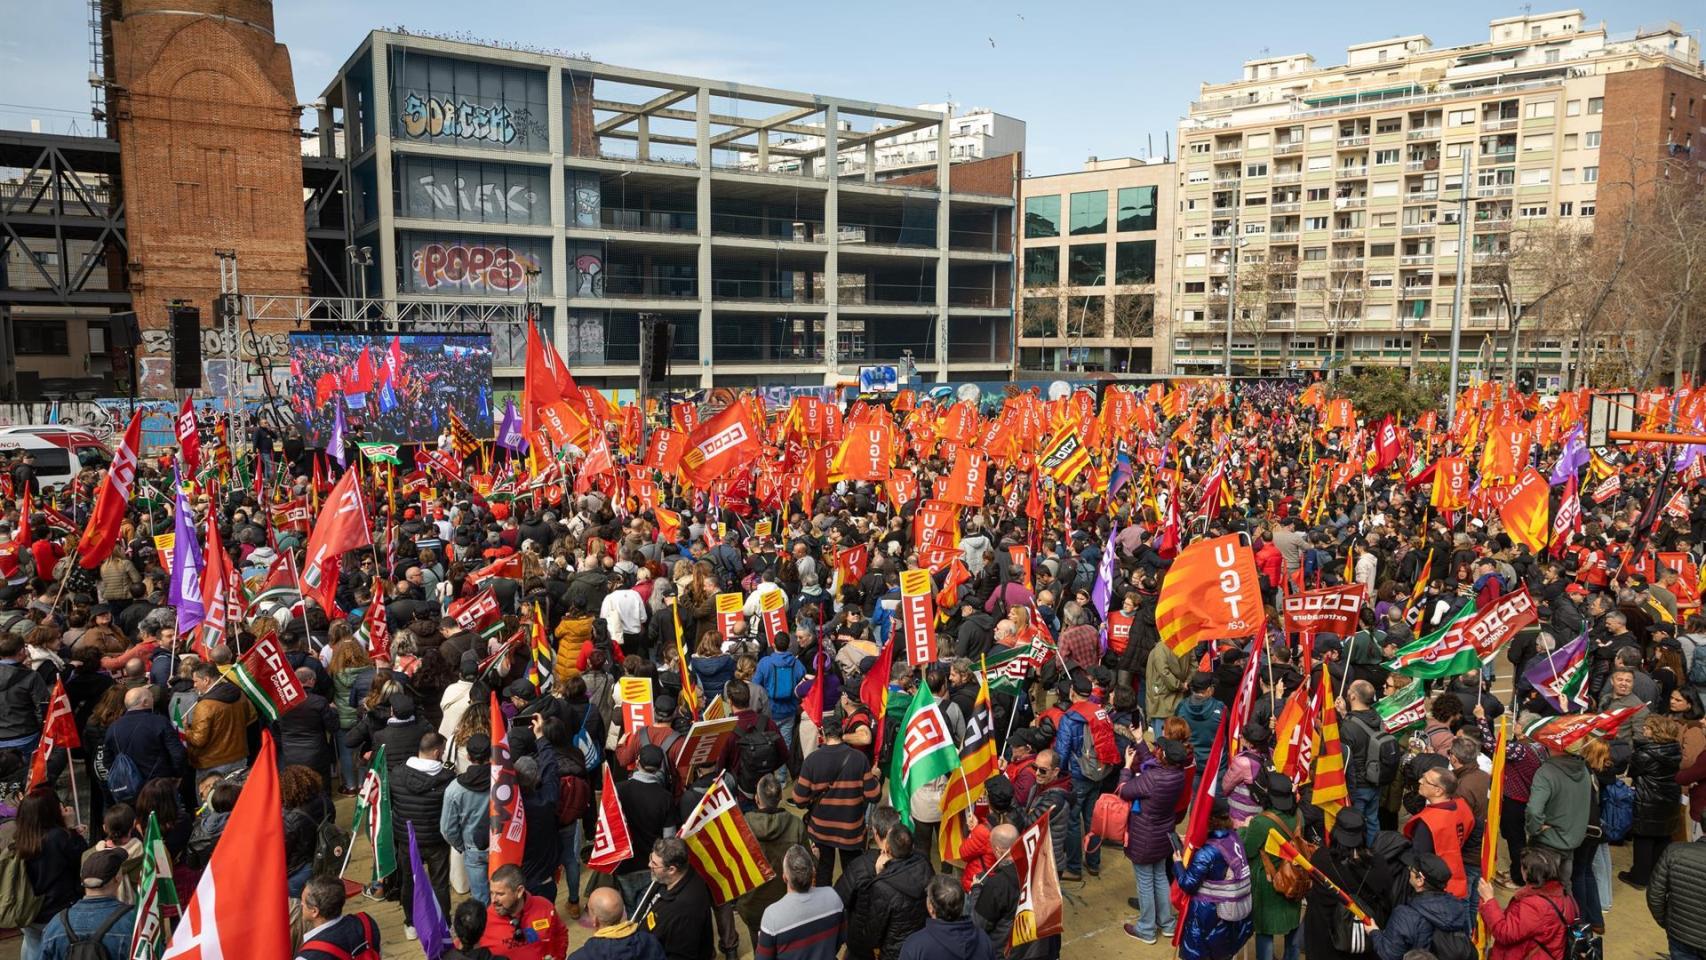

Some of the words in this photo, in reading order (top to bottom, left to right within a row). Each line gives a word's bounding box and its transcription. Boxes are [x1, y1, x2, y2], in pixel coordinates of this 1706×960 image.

[546, 407, 565, 435] UGT
[657, 430, 670, 461] UGT
[1504, 473, 1536, 504] UGT
[911, 596, 930, 662] CCOO
[256, 640, 298, 702] CCOO
